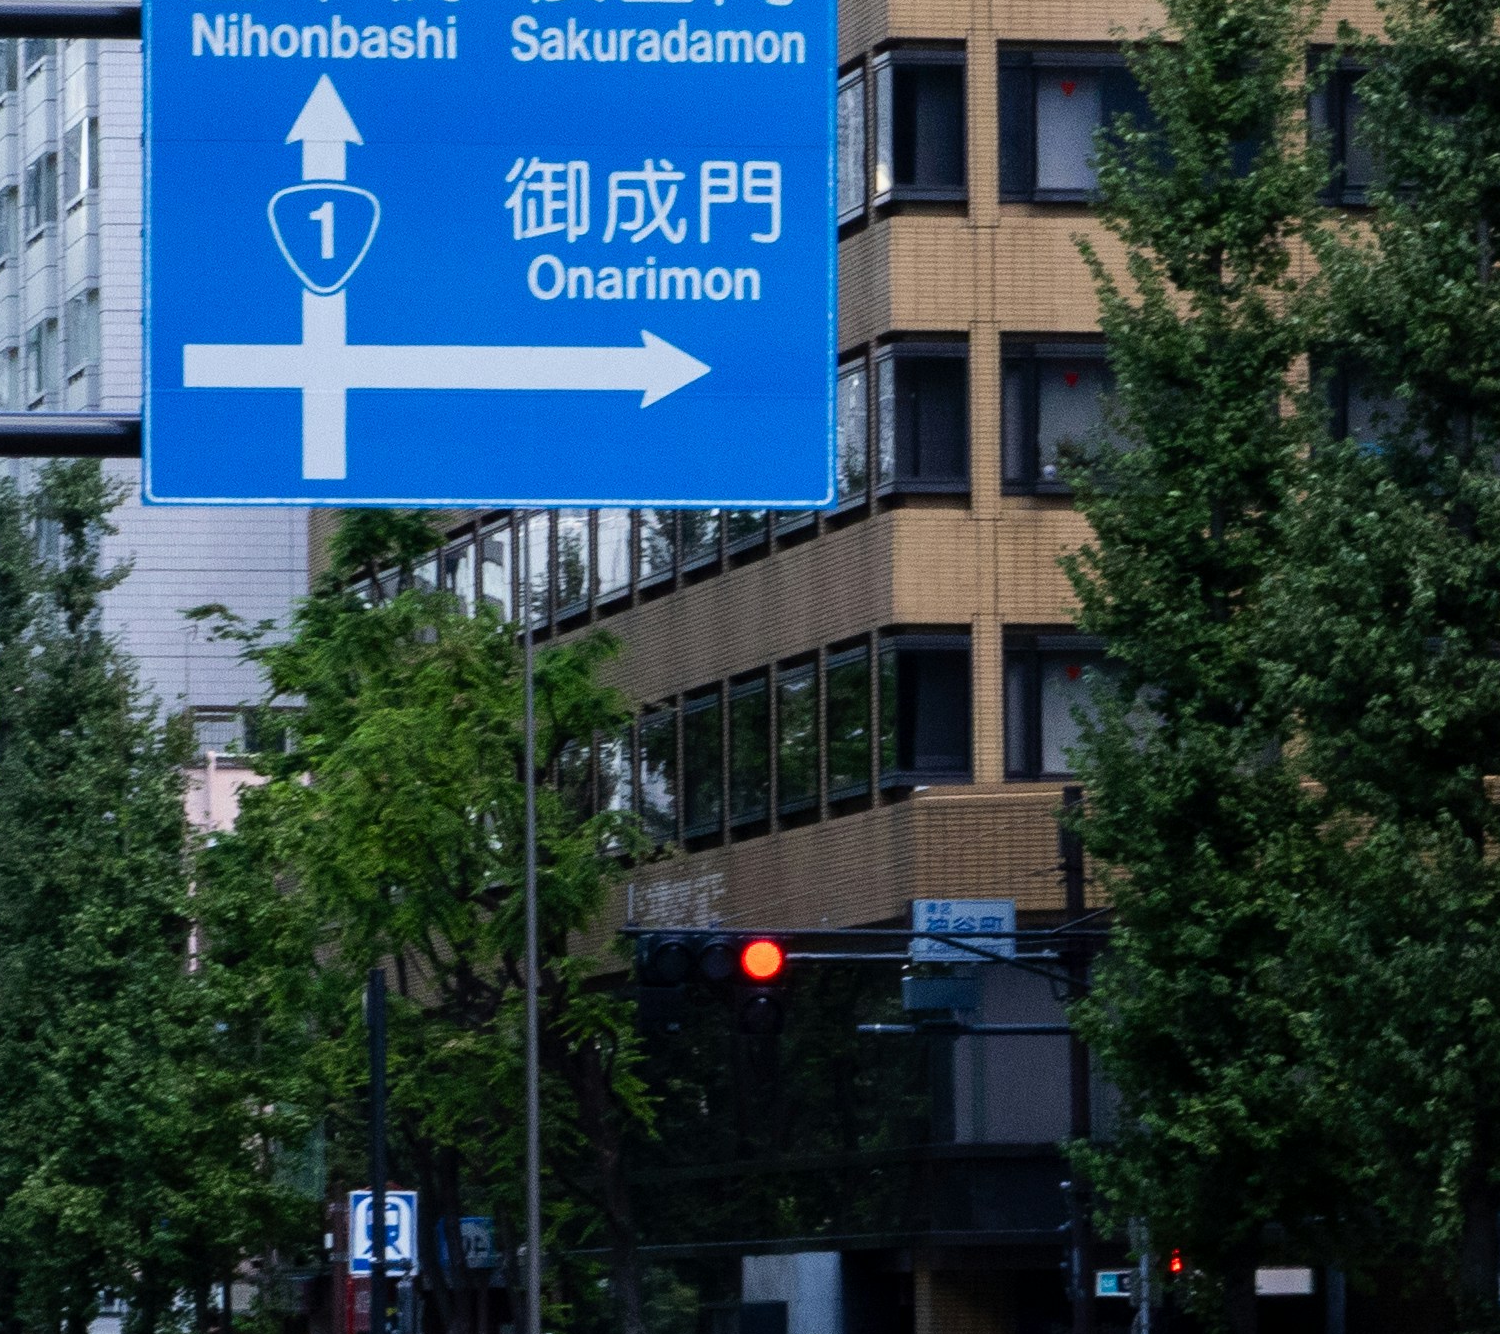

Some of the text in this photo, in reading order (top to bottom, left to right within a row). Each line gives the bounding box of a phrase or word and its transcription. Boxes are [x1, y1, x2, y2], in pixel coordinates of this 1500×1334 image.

[191, 13, 806, 65] Nihonbashi Sakuradamon
[503, 157, 782, 245] 御成門
[308, 202, 336, 260] 1
[527, 254, 761, 302] Onarimon
